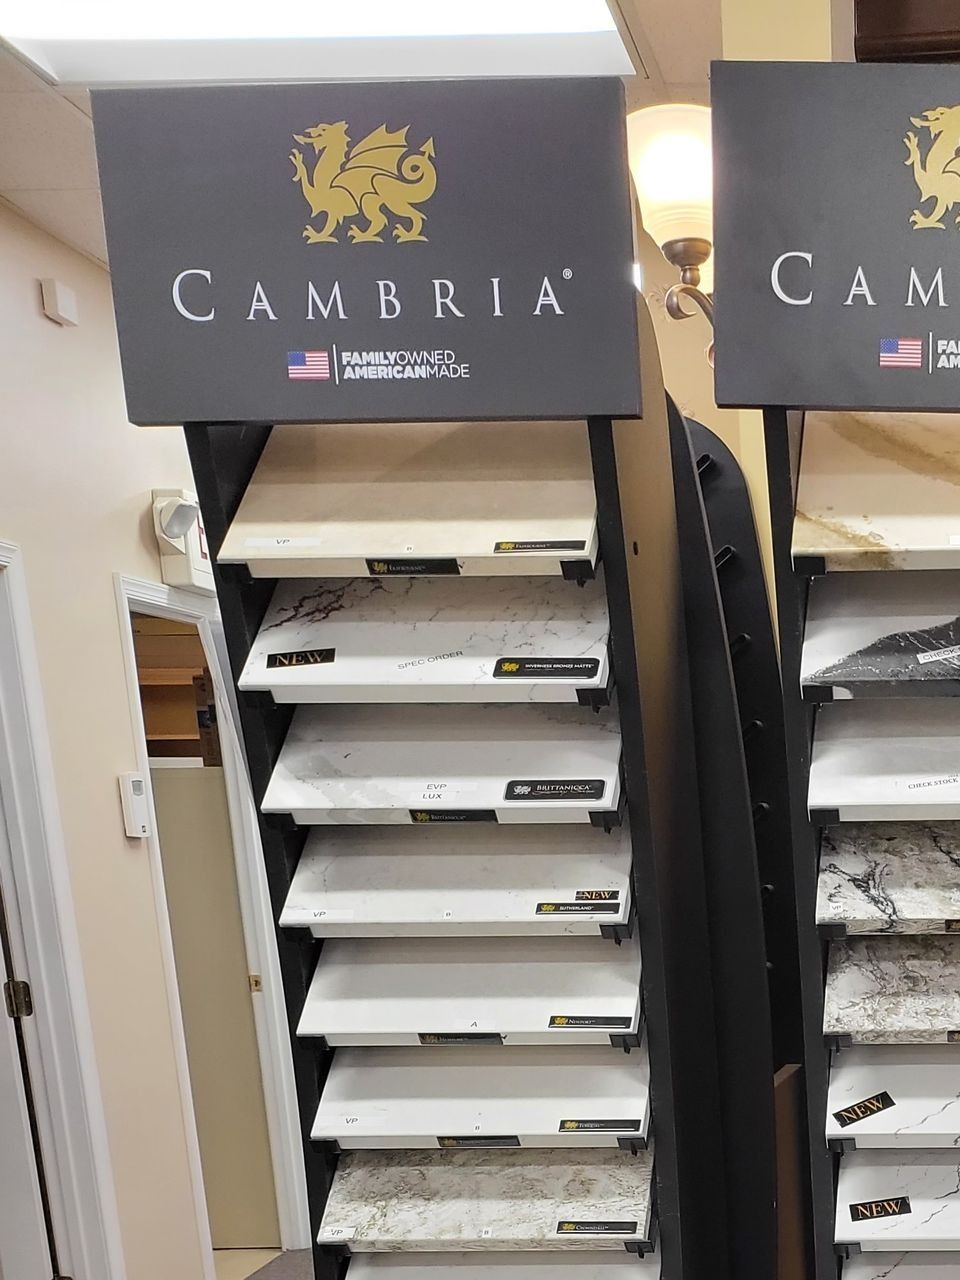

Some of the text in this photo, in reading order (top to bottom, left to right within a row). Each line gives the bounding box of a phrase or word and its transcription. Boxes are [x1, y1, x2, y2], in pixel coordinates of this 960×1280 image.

[275, 651, 326, 667] NEW
[397, 650, 464, 671] SPEC ORDER
[922, 647, 957, 662] CHECK
[907, 776, 959, 790] CHECK STOCK
[582, 891, 612, 900] NEW
[841, 1097, 885, 1124] NEW
[857, 1200, 902, 1219] NEW
